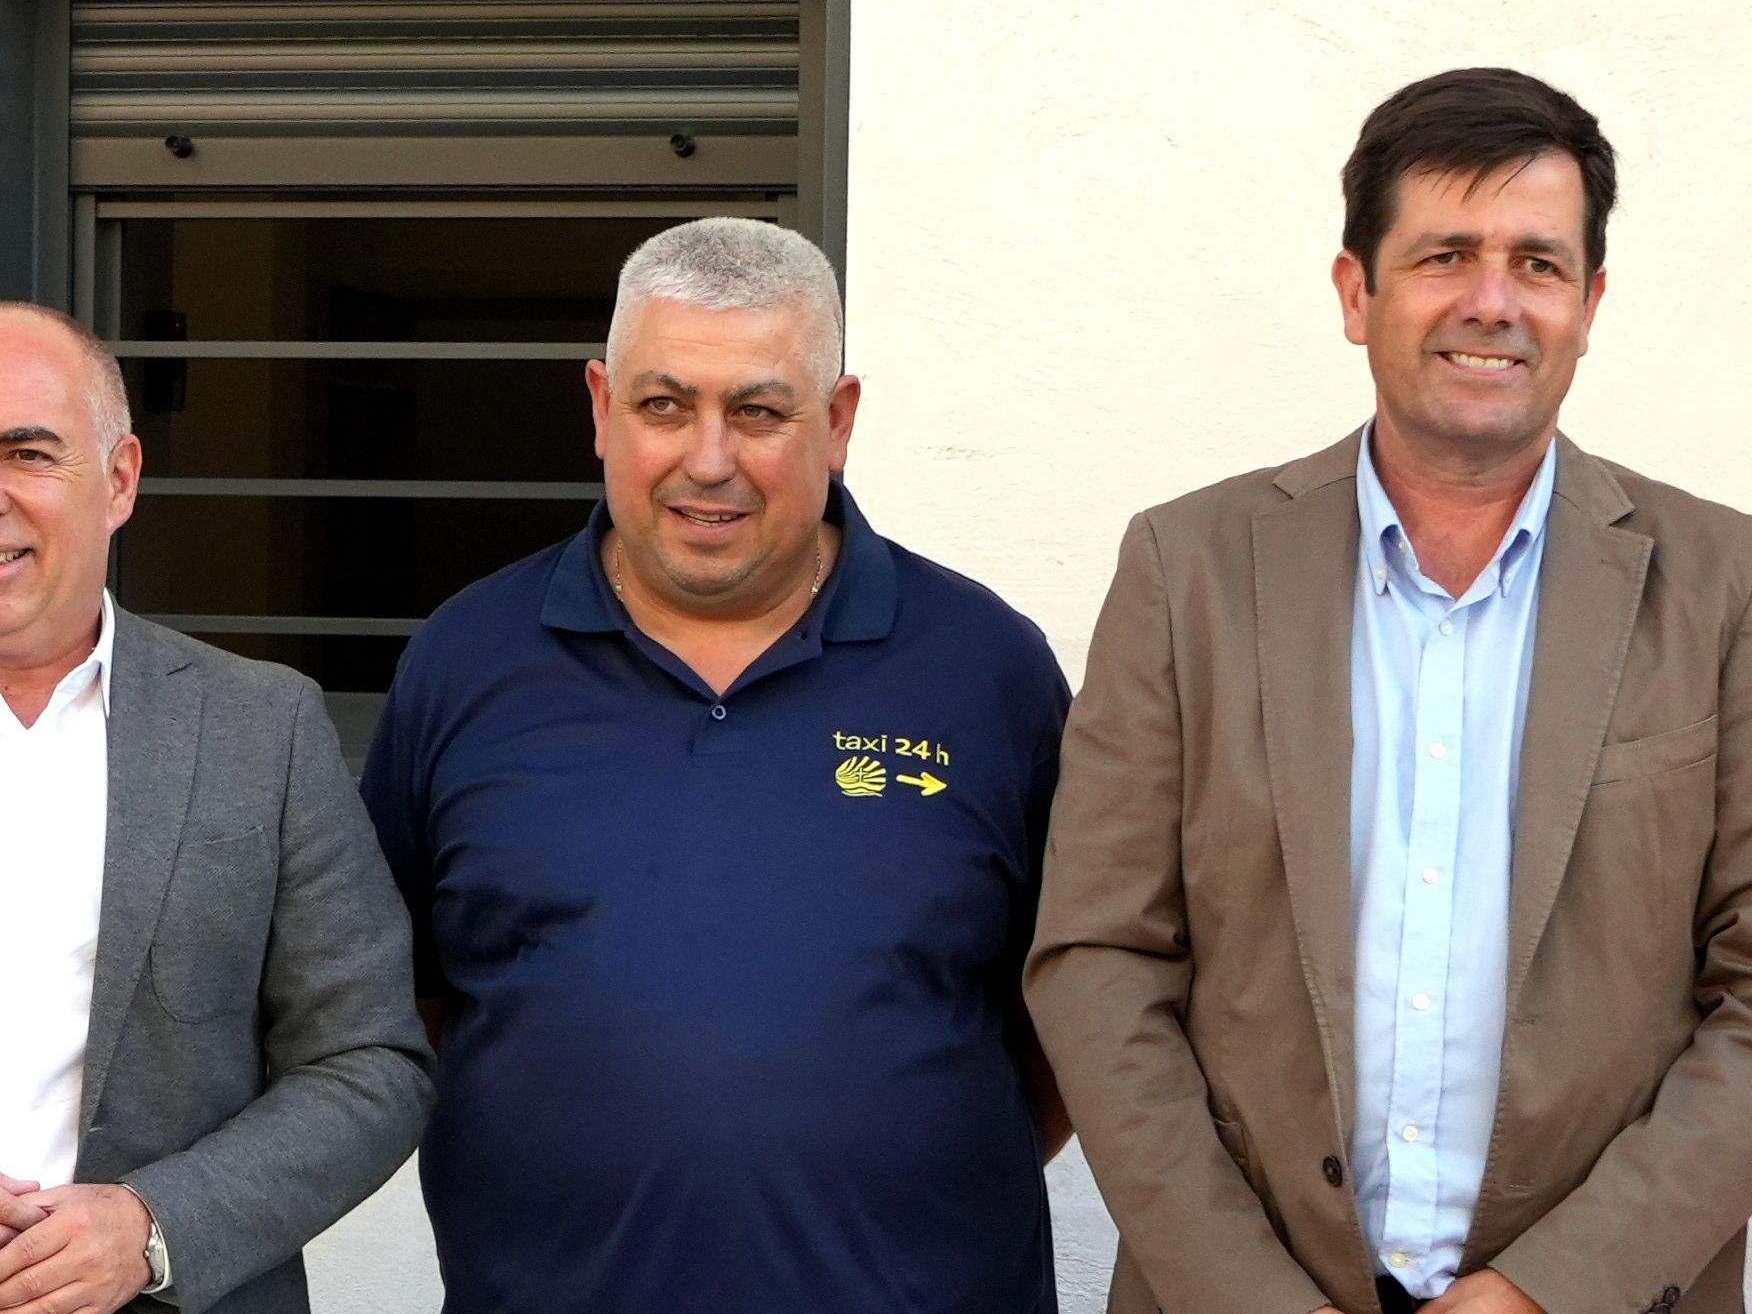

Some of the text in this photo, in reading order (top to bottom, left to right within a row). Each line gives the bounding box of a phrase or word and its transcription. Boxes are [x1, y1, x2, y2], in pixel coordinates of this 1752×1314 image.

[832, 731, 949, 766] taxi 24 h
